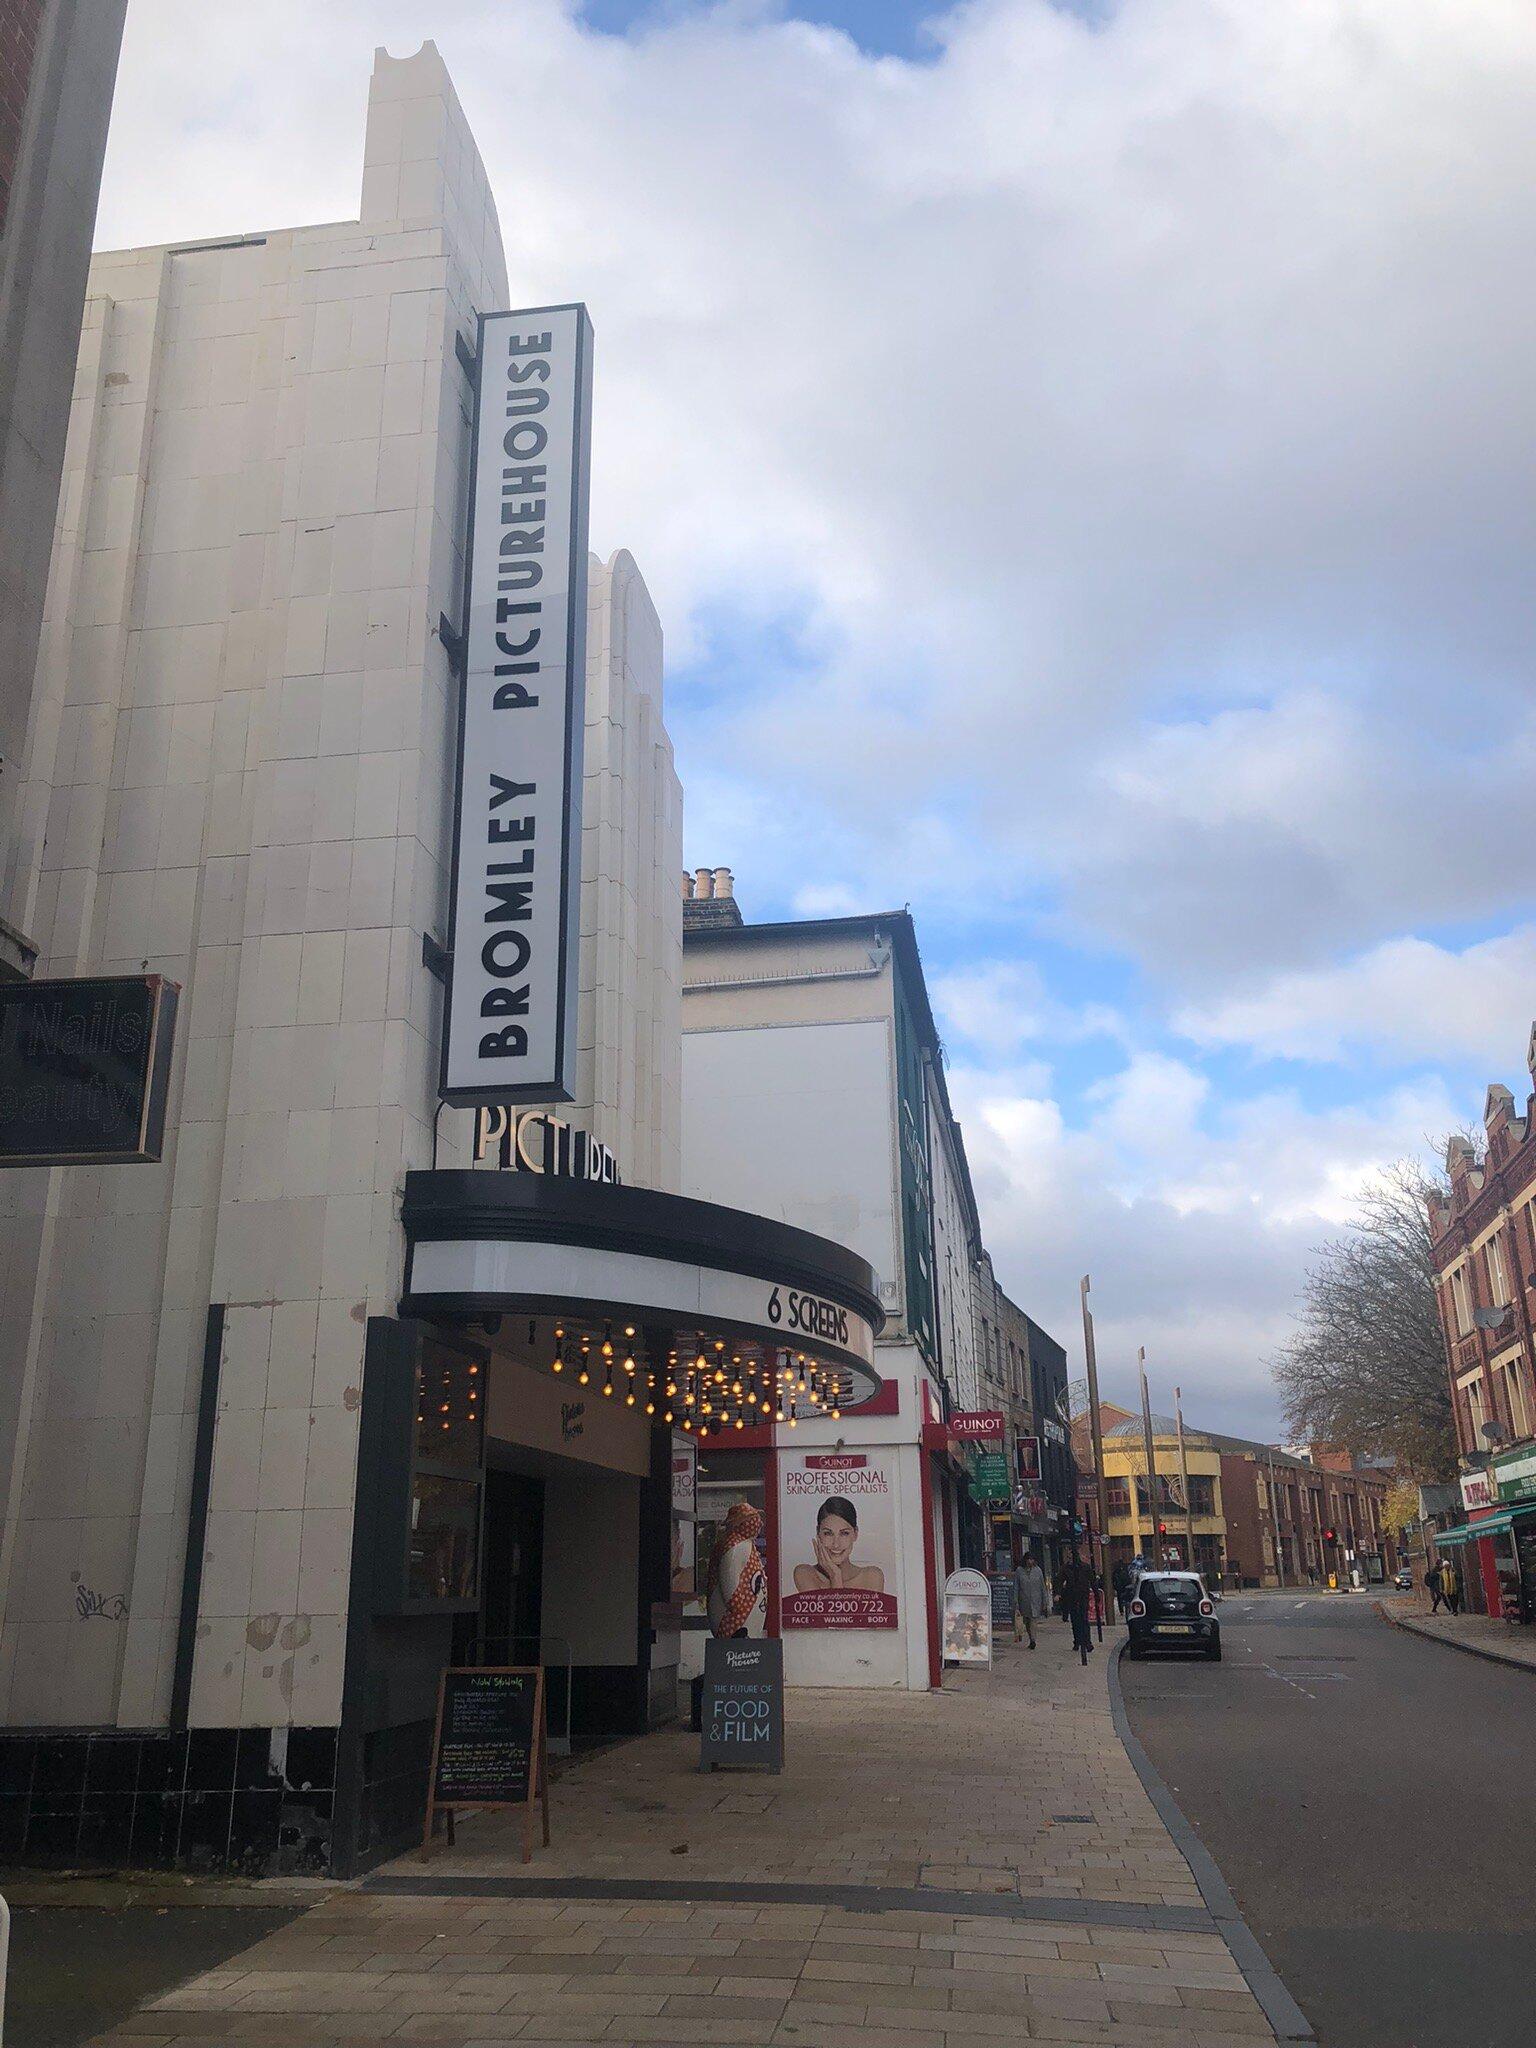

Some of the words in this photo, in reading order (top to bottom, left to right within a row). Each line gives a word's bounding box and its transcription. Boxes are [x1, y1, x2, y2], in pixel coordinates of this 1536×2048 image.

[493, 331, 552, 710] PICTUREHOUSE
[478, 773, 537, 1059] BROMLEY
[27, 1000, 143, 1056] Nails
[768, 1287, 781, 1323] 6
[788, 1292, 849, 1345] SCREENS
[953, 1419, 1002, 1431] GUINOT
[786, 1471, 887, 1485] PROFESSIONAL
[786, 1485, 831, 1495] SKINCARE
[834, 1484, 889, 1494] SPECIALISTS
[794, 1601, 824, 1613] 0208
[828, 1600, 858, 1612] 2900
[861, 1600, 884, 1612] 722
[791, 1616, 810, 1624] FACE
[824, 1616, 854, 1624] WAXING
[867, 1616, 889, 1624] BODY
[725, 1650, 762, 1665] Picture
[731, 1657, 760, 1667] house
[714, 1684, 727, 1694] THE
[729, 1684, 758, 1694] FUTURE
[761, 1684, 773, 1694] OF
[714, 1700, 770, 1718] FOOD
[709, 1723, 721, 1741] &
[724, 1722, 770, 1742] FILM
